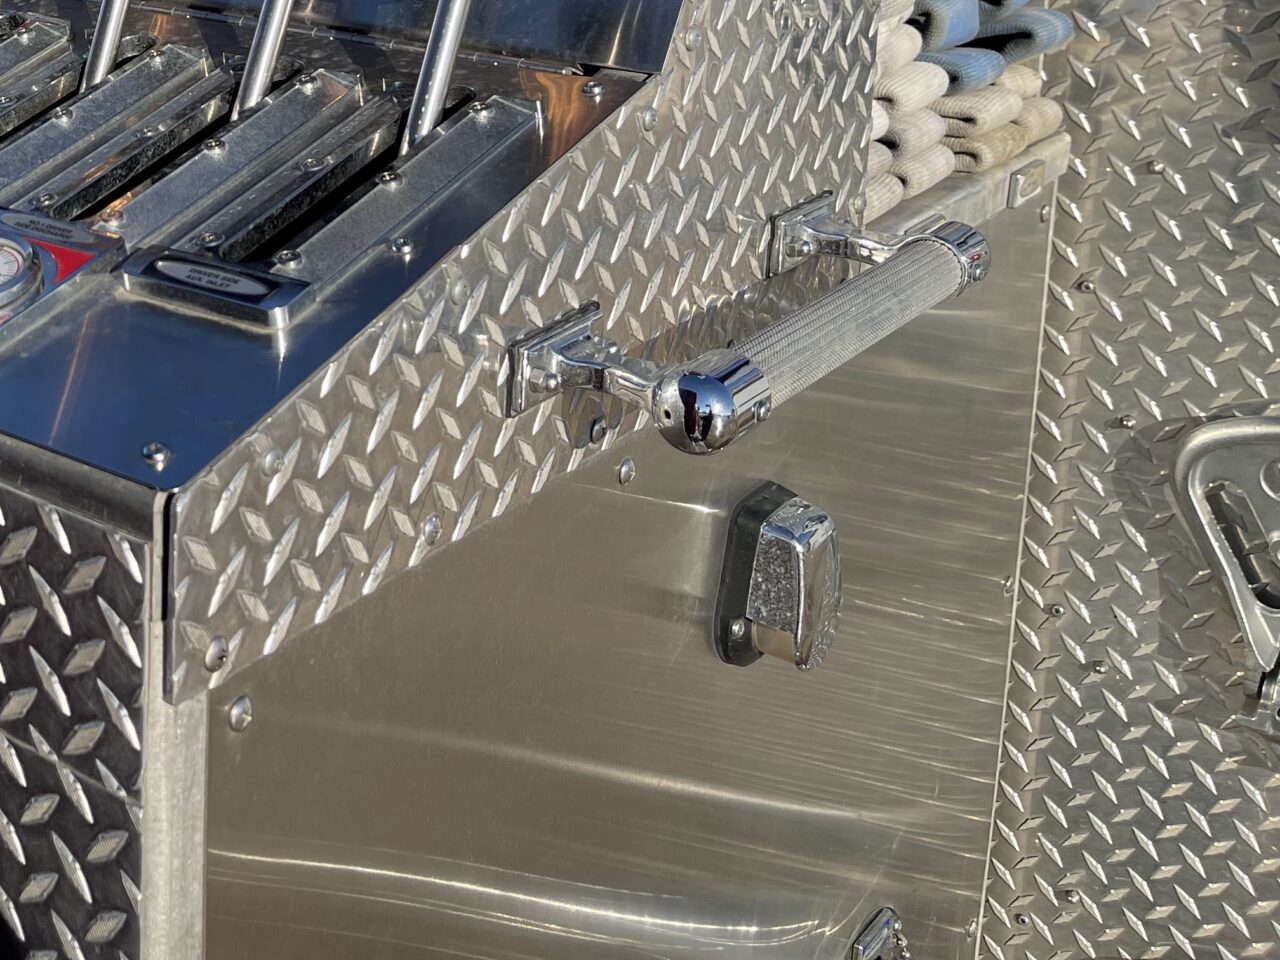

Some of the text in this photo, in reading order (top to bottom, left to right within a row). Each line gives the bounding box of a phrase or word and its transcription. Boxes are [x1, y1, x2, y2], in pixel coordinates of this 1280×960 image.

[189, 267, 241, 284] DRIVER SIDE
[205, 279, 231, 288] INLET
